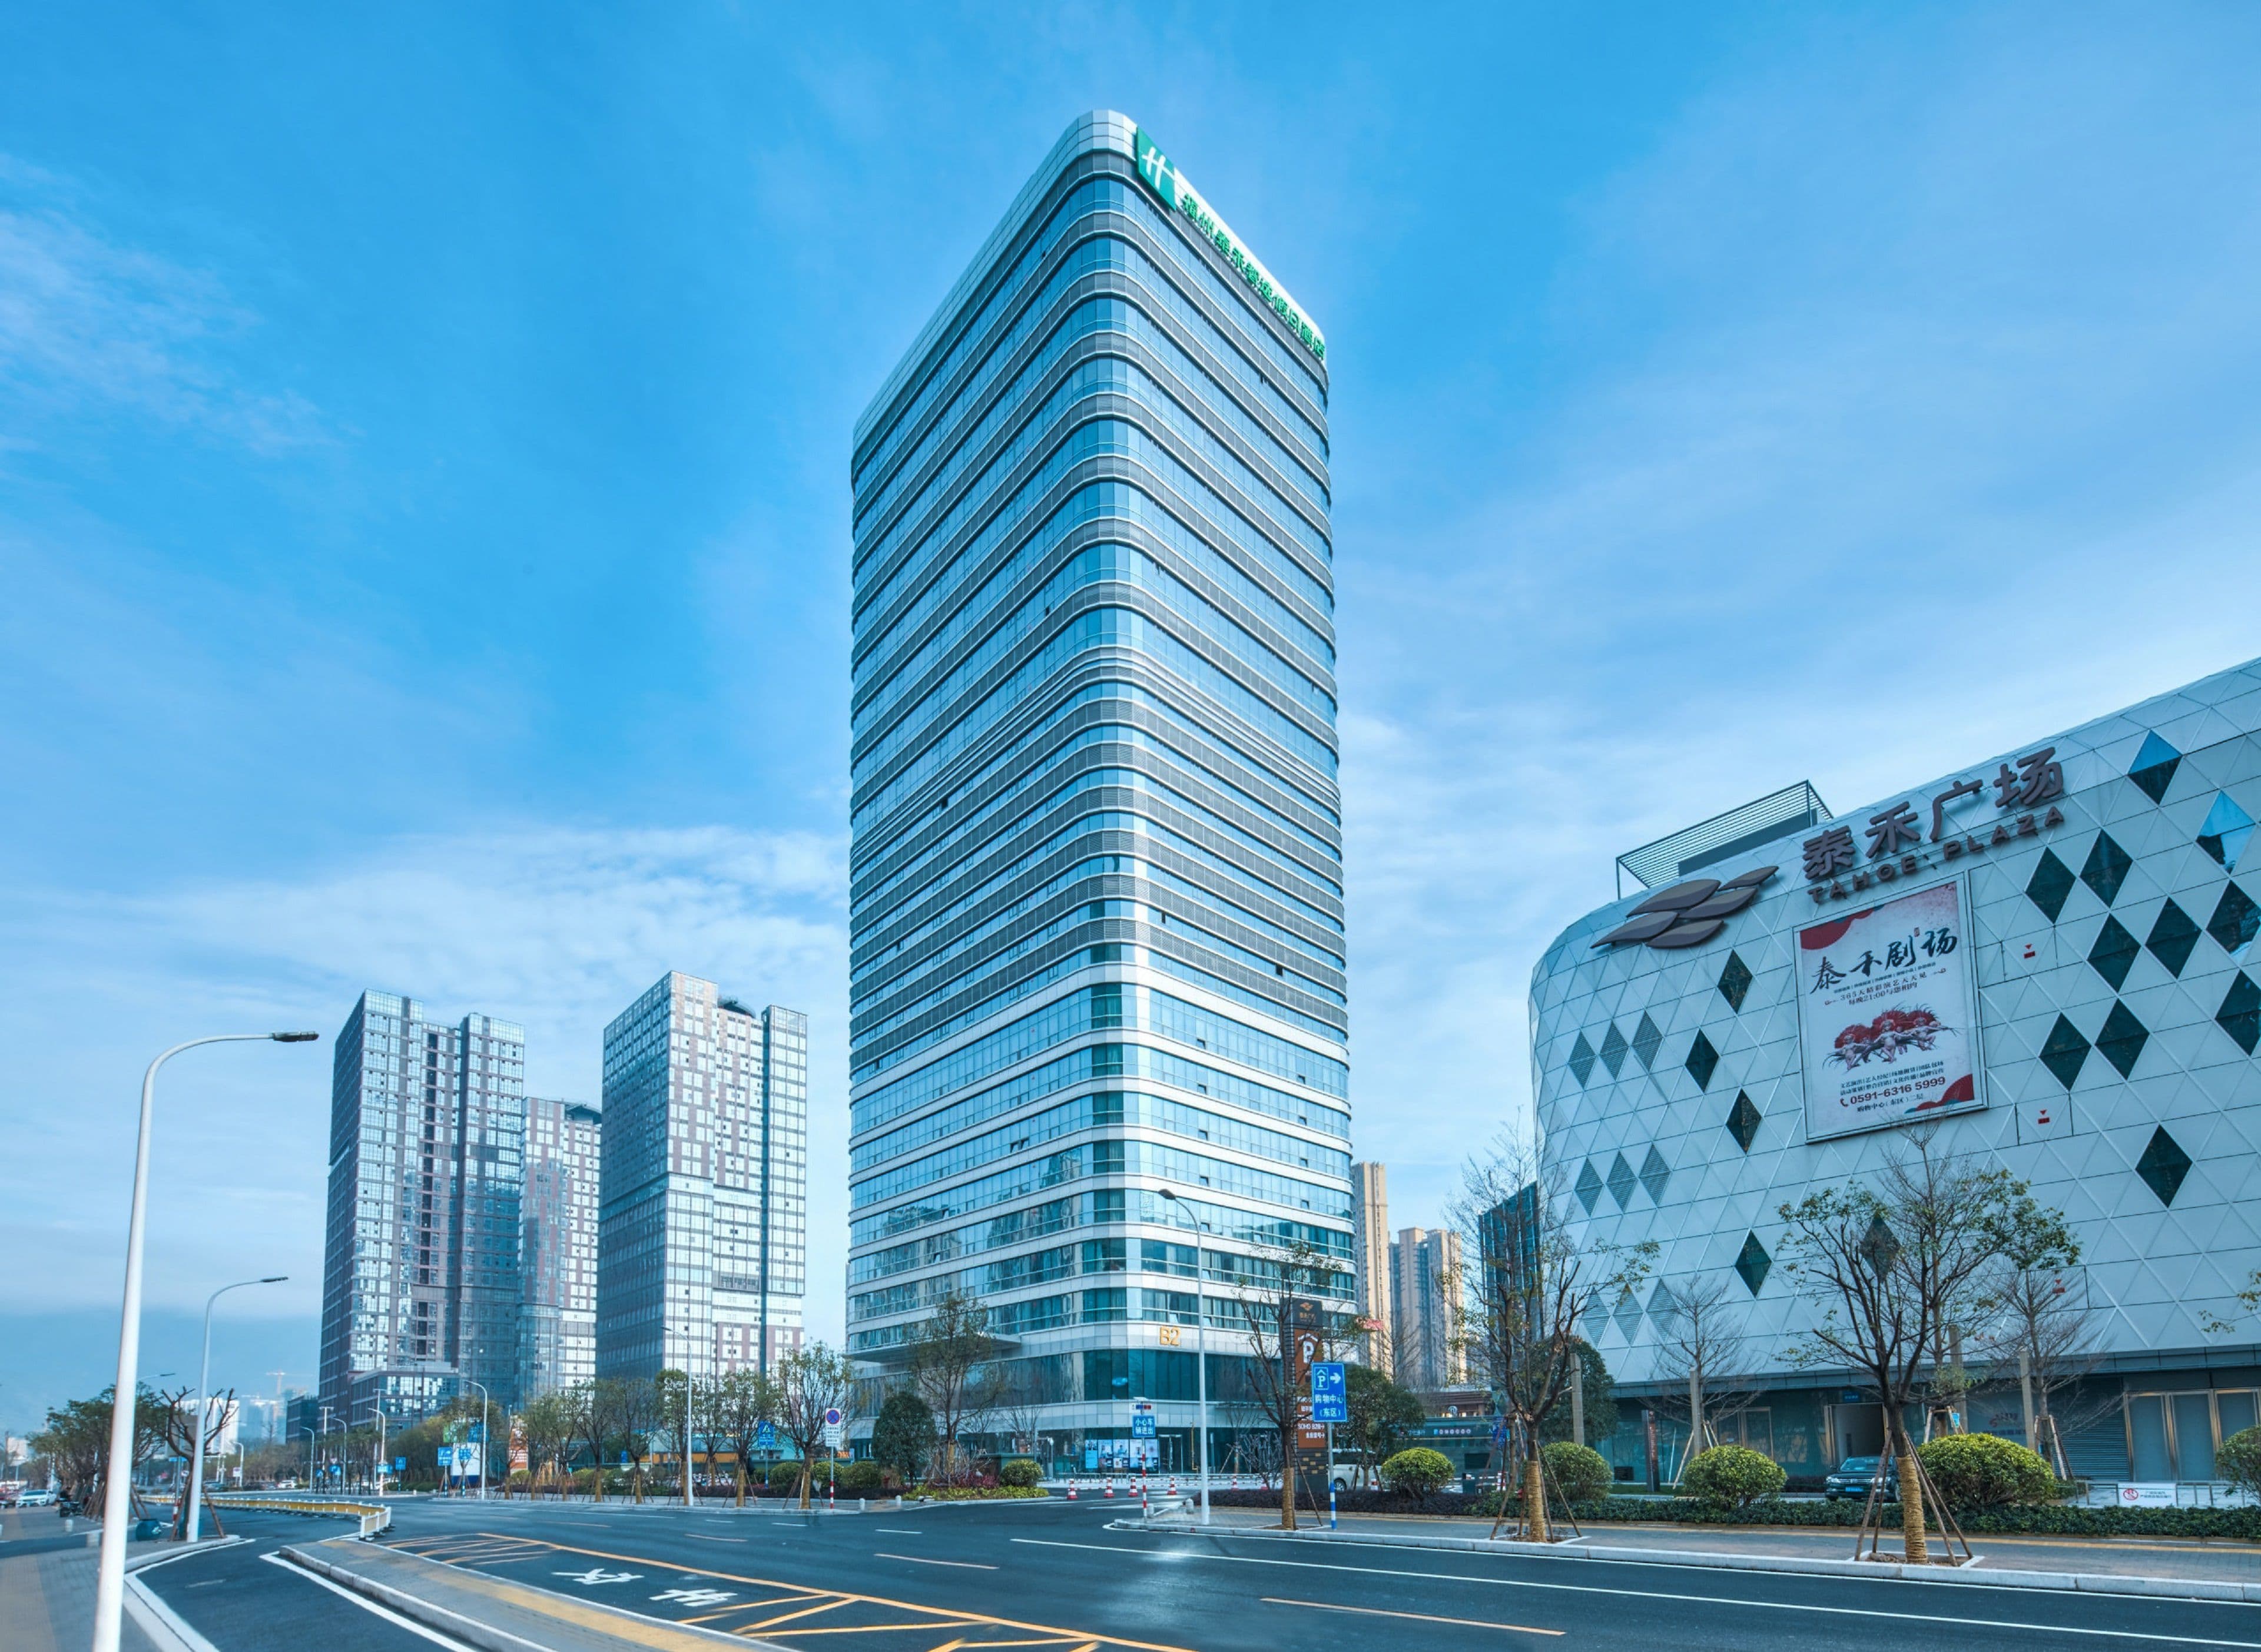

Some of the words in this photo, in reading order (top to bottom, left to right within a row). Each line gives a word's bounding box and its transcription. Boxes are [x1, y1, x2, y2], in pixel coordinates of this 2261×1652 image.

[1802, 747, 2064, 880] 泰禾广场
[1807, 854, 1918, 904] TAHOE
[1943, 805, 2065, 861] PLAZA
[1809, 927, 1958, 994] 泰禾剧场
[1915, 1076, 1946, 1090] 5999
[1159, 1326, 1181, 1346] B2
[1318, 1375, 1326, 1388] P
[1314, 1394, 1343, 1404] 购物中心
[1135, 1418, 1153, 1427] 小心车
